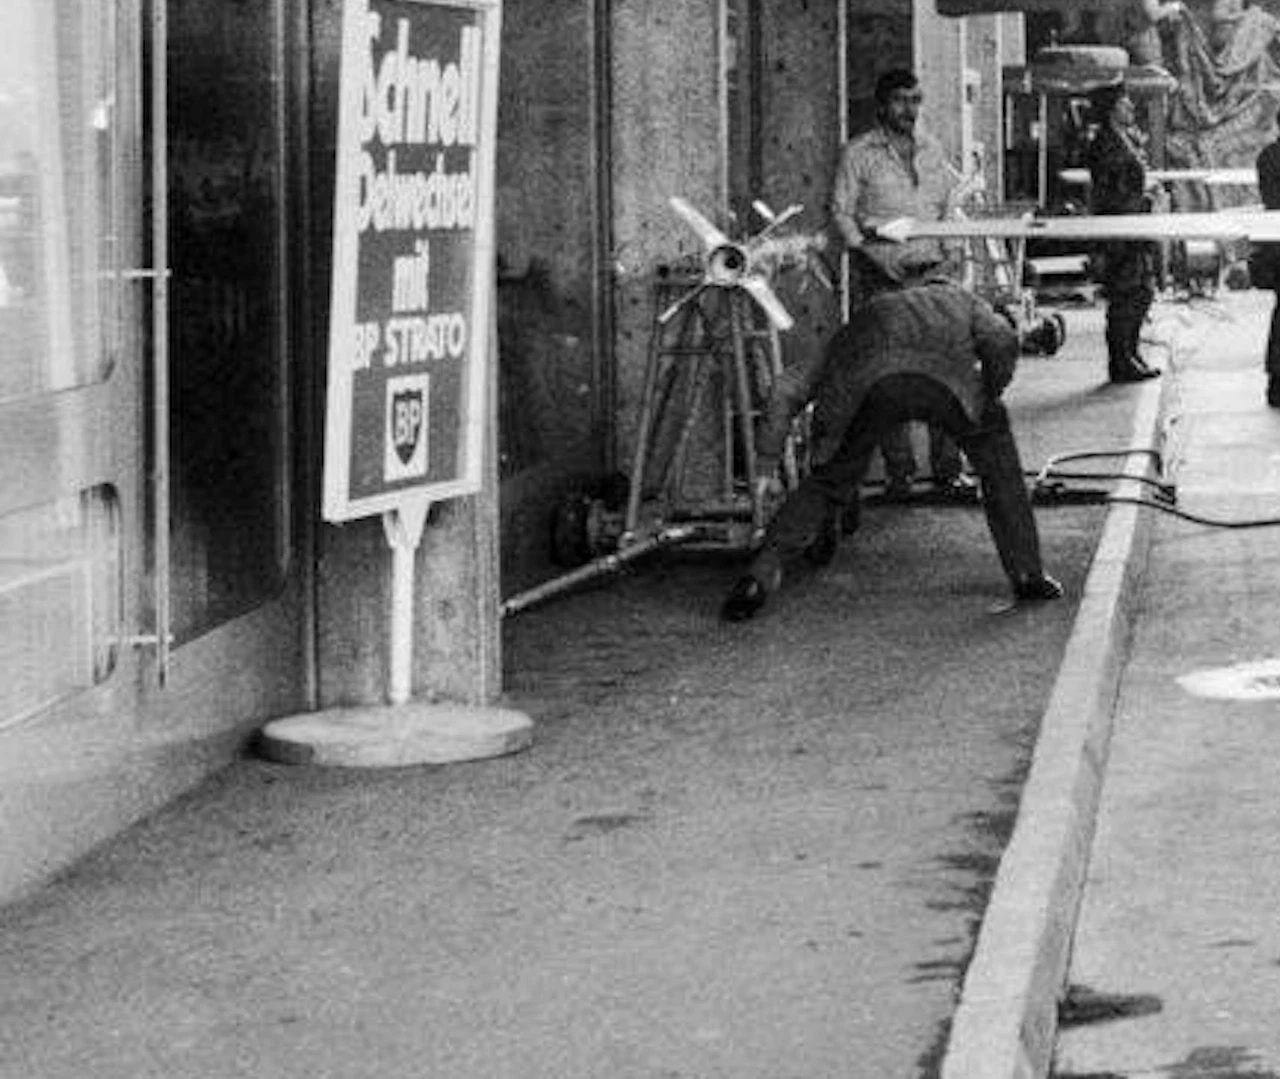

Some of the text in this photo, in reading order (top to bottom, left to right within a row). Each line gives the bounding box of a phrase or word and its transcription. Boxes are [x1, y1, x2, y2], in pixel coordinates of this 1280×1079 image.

[356, 11, 482, 146] Schnell
[350, 312, 466, 370] BP STRATO
[395, 398, 421, 445] BP
